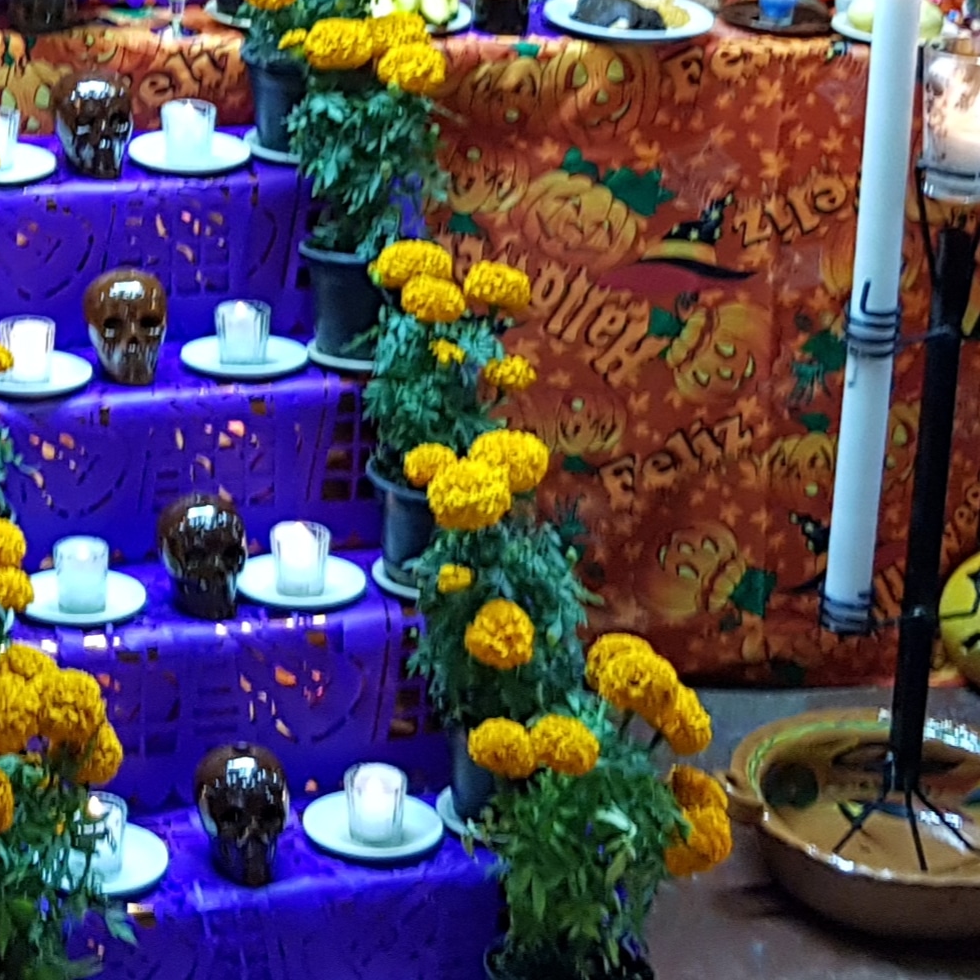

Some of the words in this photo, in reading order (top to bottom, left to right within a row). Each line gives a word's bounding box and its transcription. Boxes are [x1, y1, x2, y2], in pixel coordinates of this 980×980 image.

[137, 38, 243, 108] eliz
[731, 166, 848, 248] eliz
[598, 413, 753, 512] Feliz
